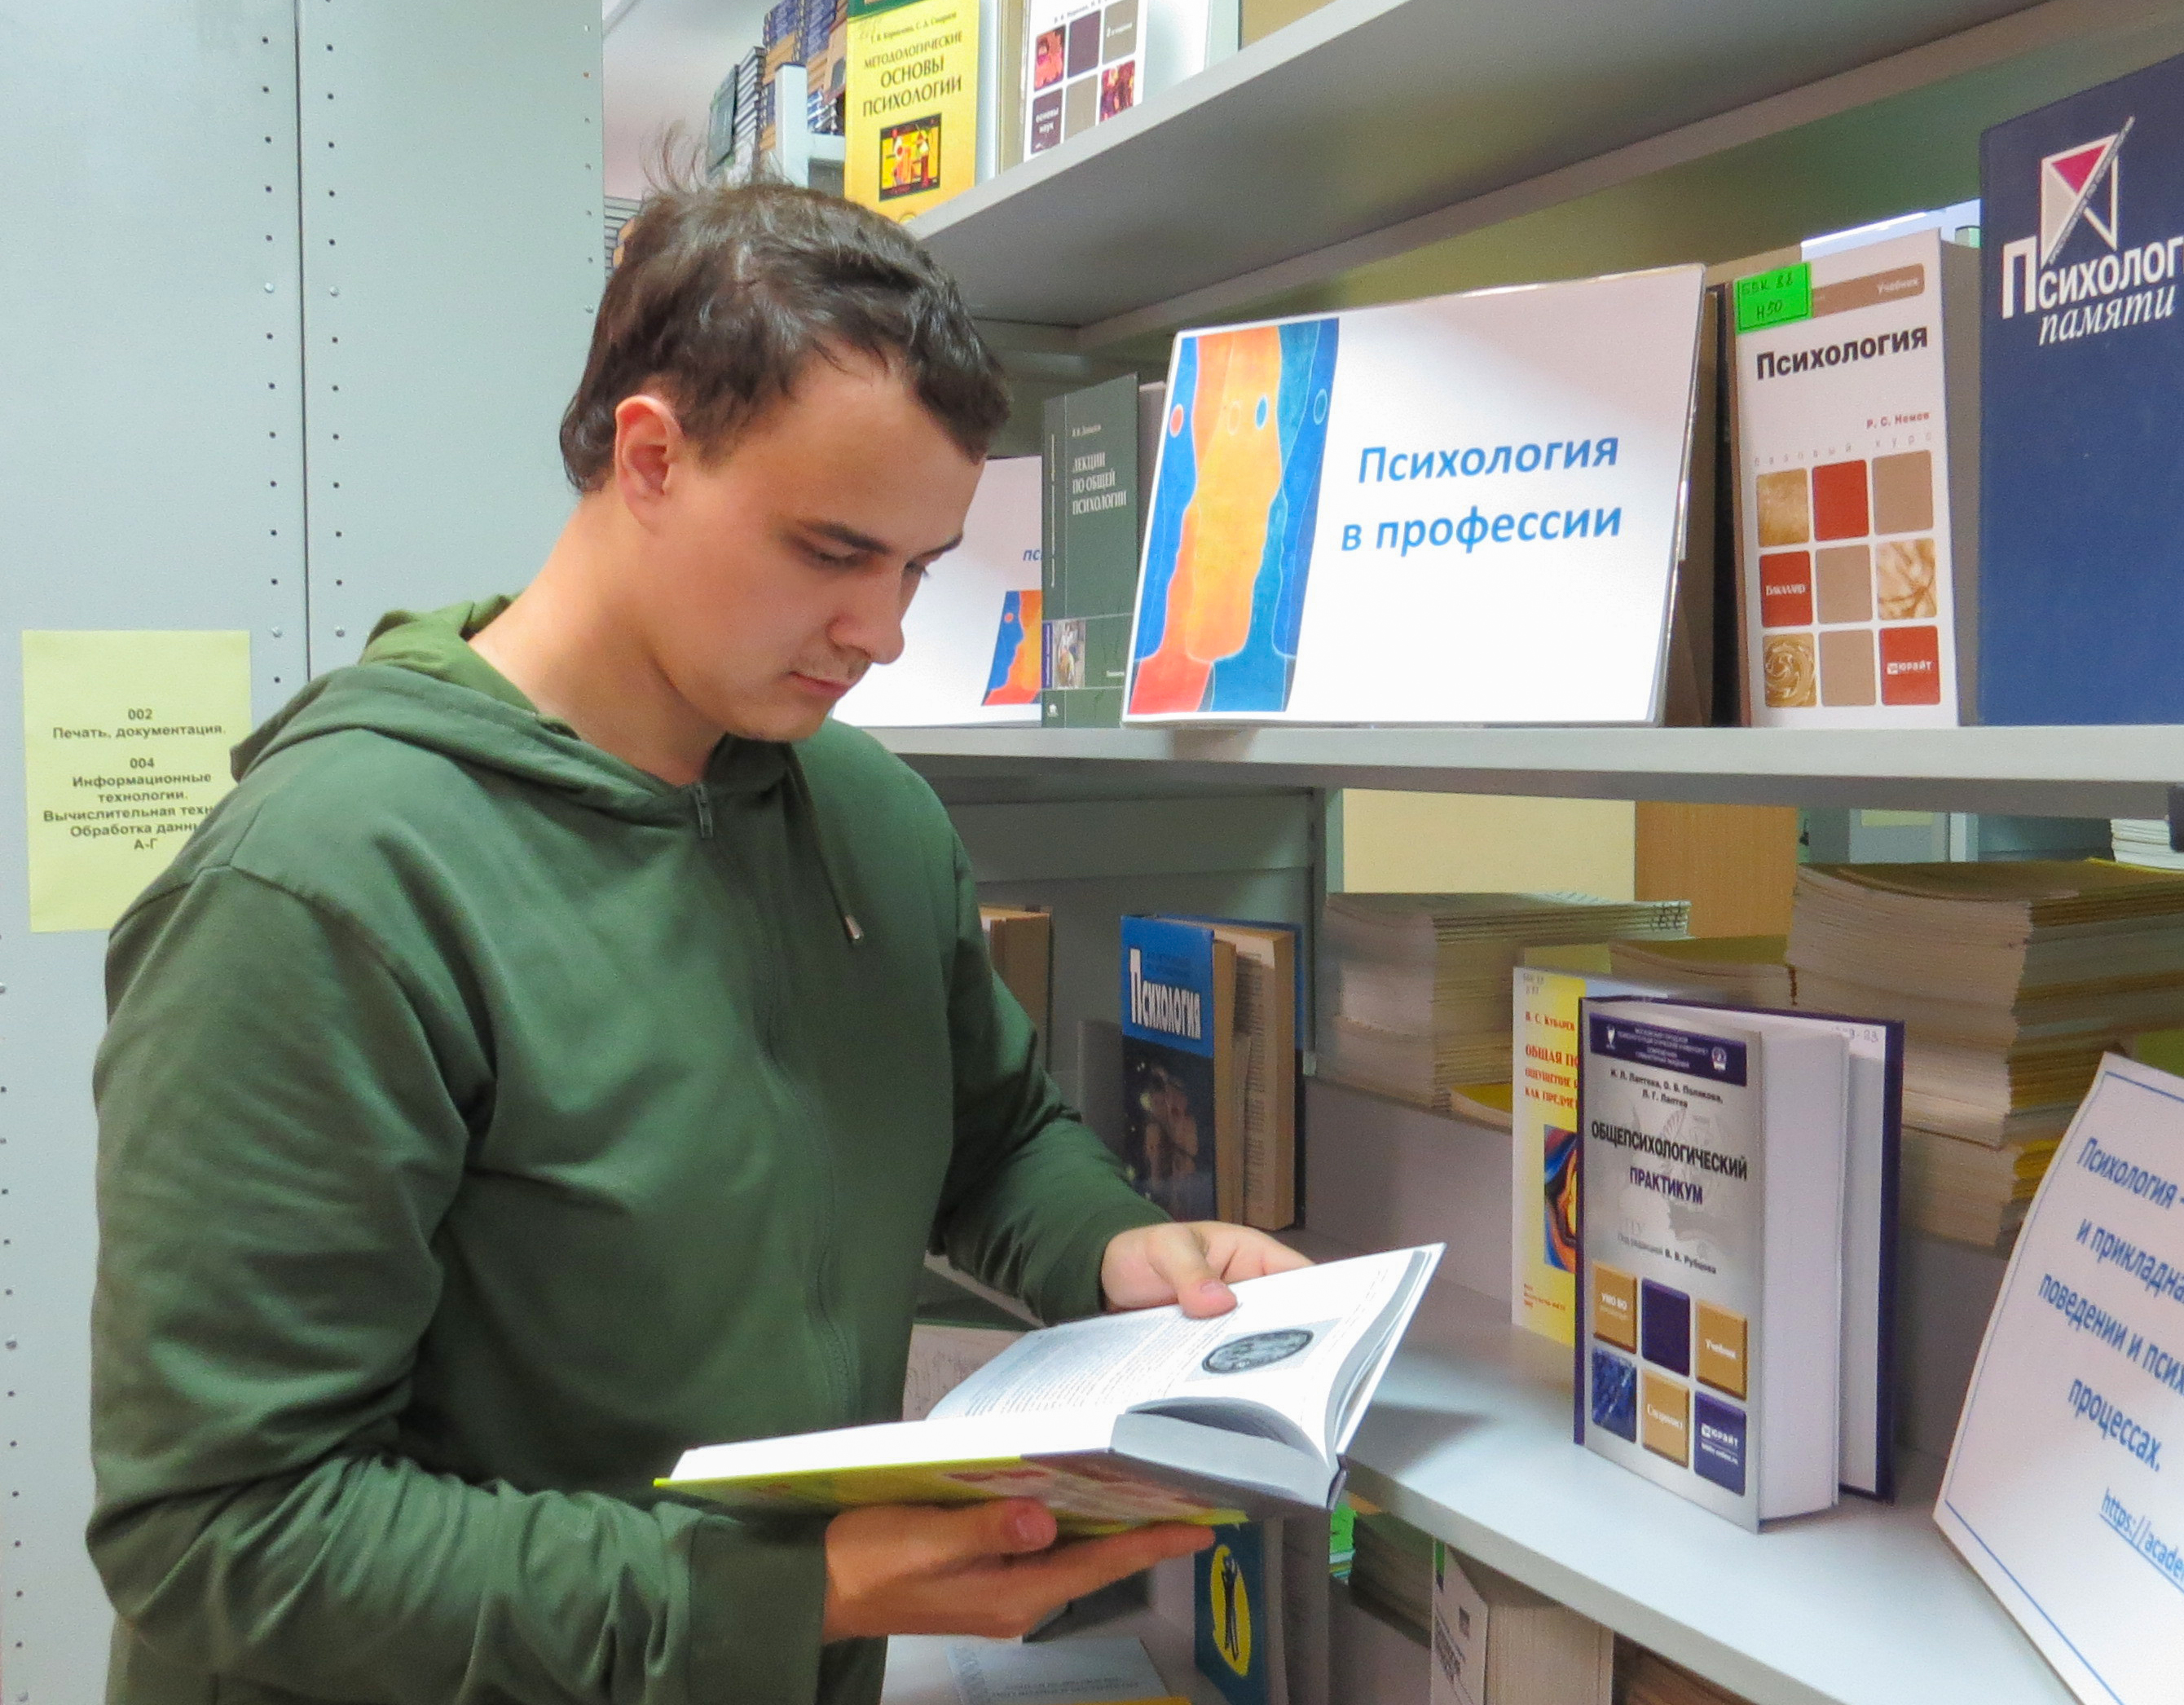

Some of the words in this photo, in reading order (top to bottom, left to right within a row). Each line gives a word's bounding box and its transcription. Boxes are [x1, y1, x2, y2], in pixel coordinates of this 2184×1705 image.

[864, 30, 962, 68] МЕТОДОЛОГИЧЕСКИЕ
[880, 54, 944, 88] ОСНОВЫ
[863, 74, 962, 117] ПСИХОЛОГИИ
[2039, 284, 2176, 346] памяти
[1757, 326, 1928, 381] Психология
[1072, 452, 1105, 474] ЛЕКЦИИ
[1358, 436, 1619, 484] Психология
[1072, 478, 1085, 495] ПО
[1085, 467, 1116, 491] ОБЩЕЙ
[1072, 490, 1127, 515] ПСИХОЛОГИИ
[1341, 523, 1363, 551] в
[1376, 504, 1622, 557] профессии
[127, 708, 153, 720] 002
[52, 727, 112, 740] Печать,
[116, 724, 227, 738] документация.
[130, 757, 155, 769] 004
[73, 773, 212, 789] Информационные
[98, 791, 188, 804] технологии.
[43, 806, 176, 822] Вычислительная
[70, 824, 152, 838] Обработка
[134, 839, 158, 850] А-Г
[1526, 1044, 1562, 1064] ОБЩАЯ
[1525, 1086, 1540, 1099] КАК
[1543, 1090, 1579, 1109] ПРЕДМЕ
[1592, 1120, 1748, 1182] ОБЩЕПСИХОЛОГИЧЕСКИЙ
[1630, 1165, 1703, 1205] ПРАКТИКУМ
[2076, 1137, 2178, 1209] Психология
[2076, 1218, 2092, 1245] и
[2038, 1273, 2128, 1352] поведении
[2126, 1332, 2144, 1363] и
[2067, 1378, 2163, 1472] процессах.
[2101, 1486, 2184, 1582] https://acade
